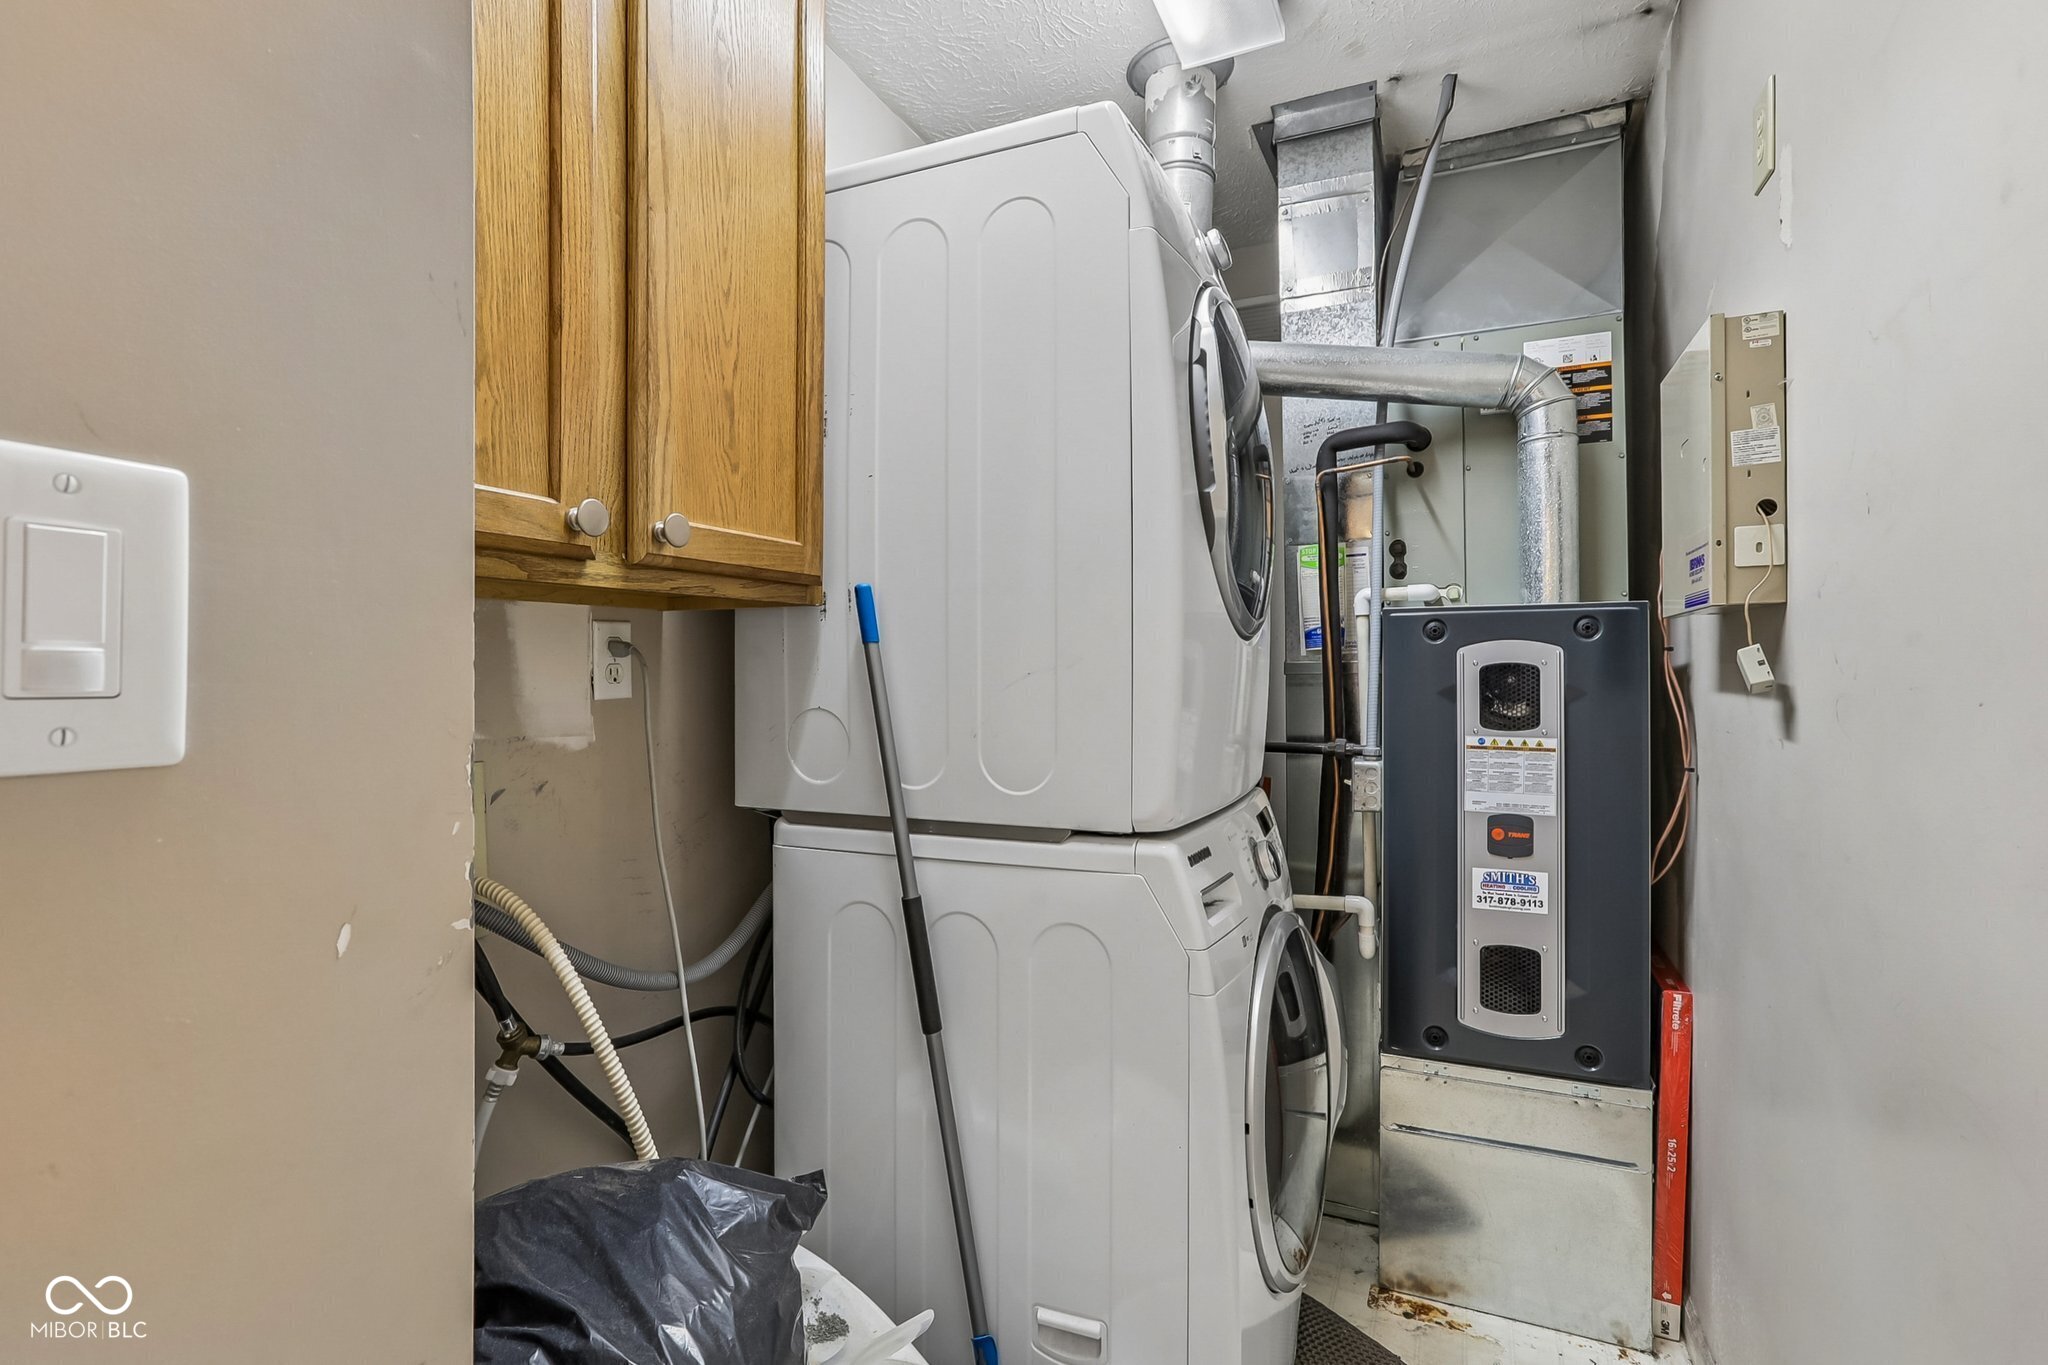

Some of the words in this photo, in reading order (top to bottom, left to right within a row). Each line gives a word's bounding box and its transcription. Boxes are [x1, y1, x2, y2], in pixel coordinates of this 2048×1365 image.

[1483, 871, 1536, 885] SMITH'S
[1476, 895, 1544, 909] 317-878-9113
[1671, 993, 1683, 1030] Filtrete
[1660, 1320, 1670, 1336] 3M
